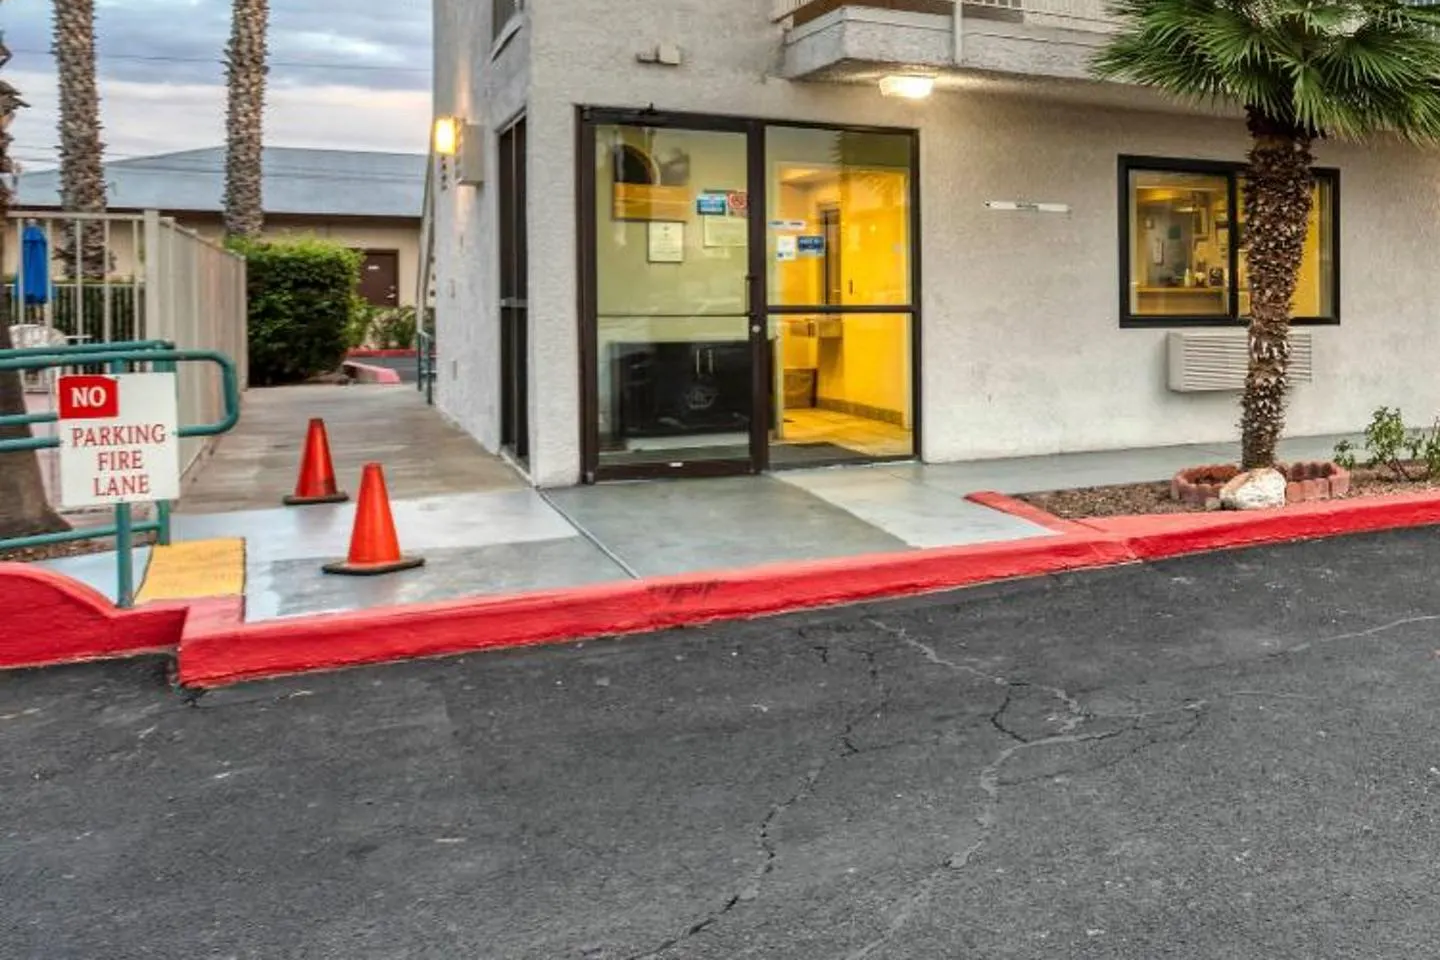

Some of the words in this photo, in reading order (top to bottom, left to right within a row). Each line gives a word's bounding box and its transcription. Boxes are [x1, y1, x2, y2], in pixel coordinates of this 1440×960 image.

[71, 386, 107, 408] NO
[71, 424, 166, 447] PARKING
[97, 450, 144, 471] FIRE
[93, 474, 150, 496] LANE
